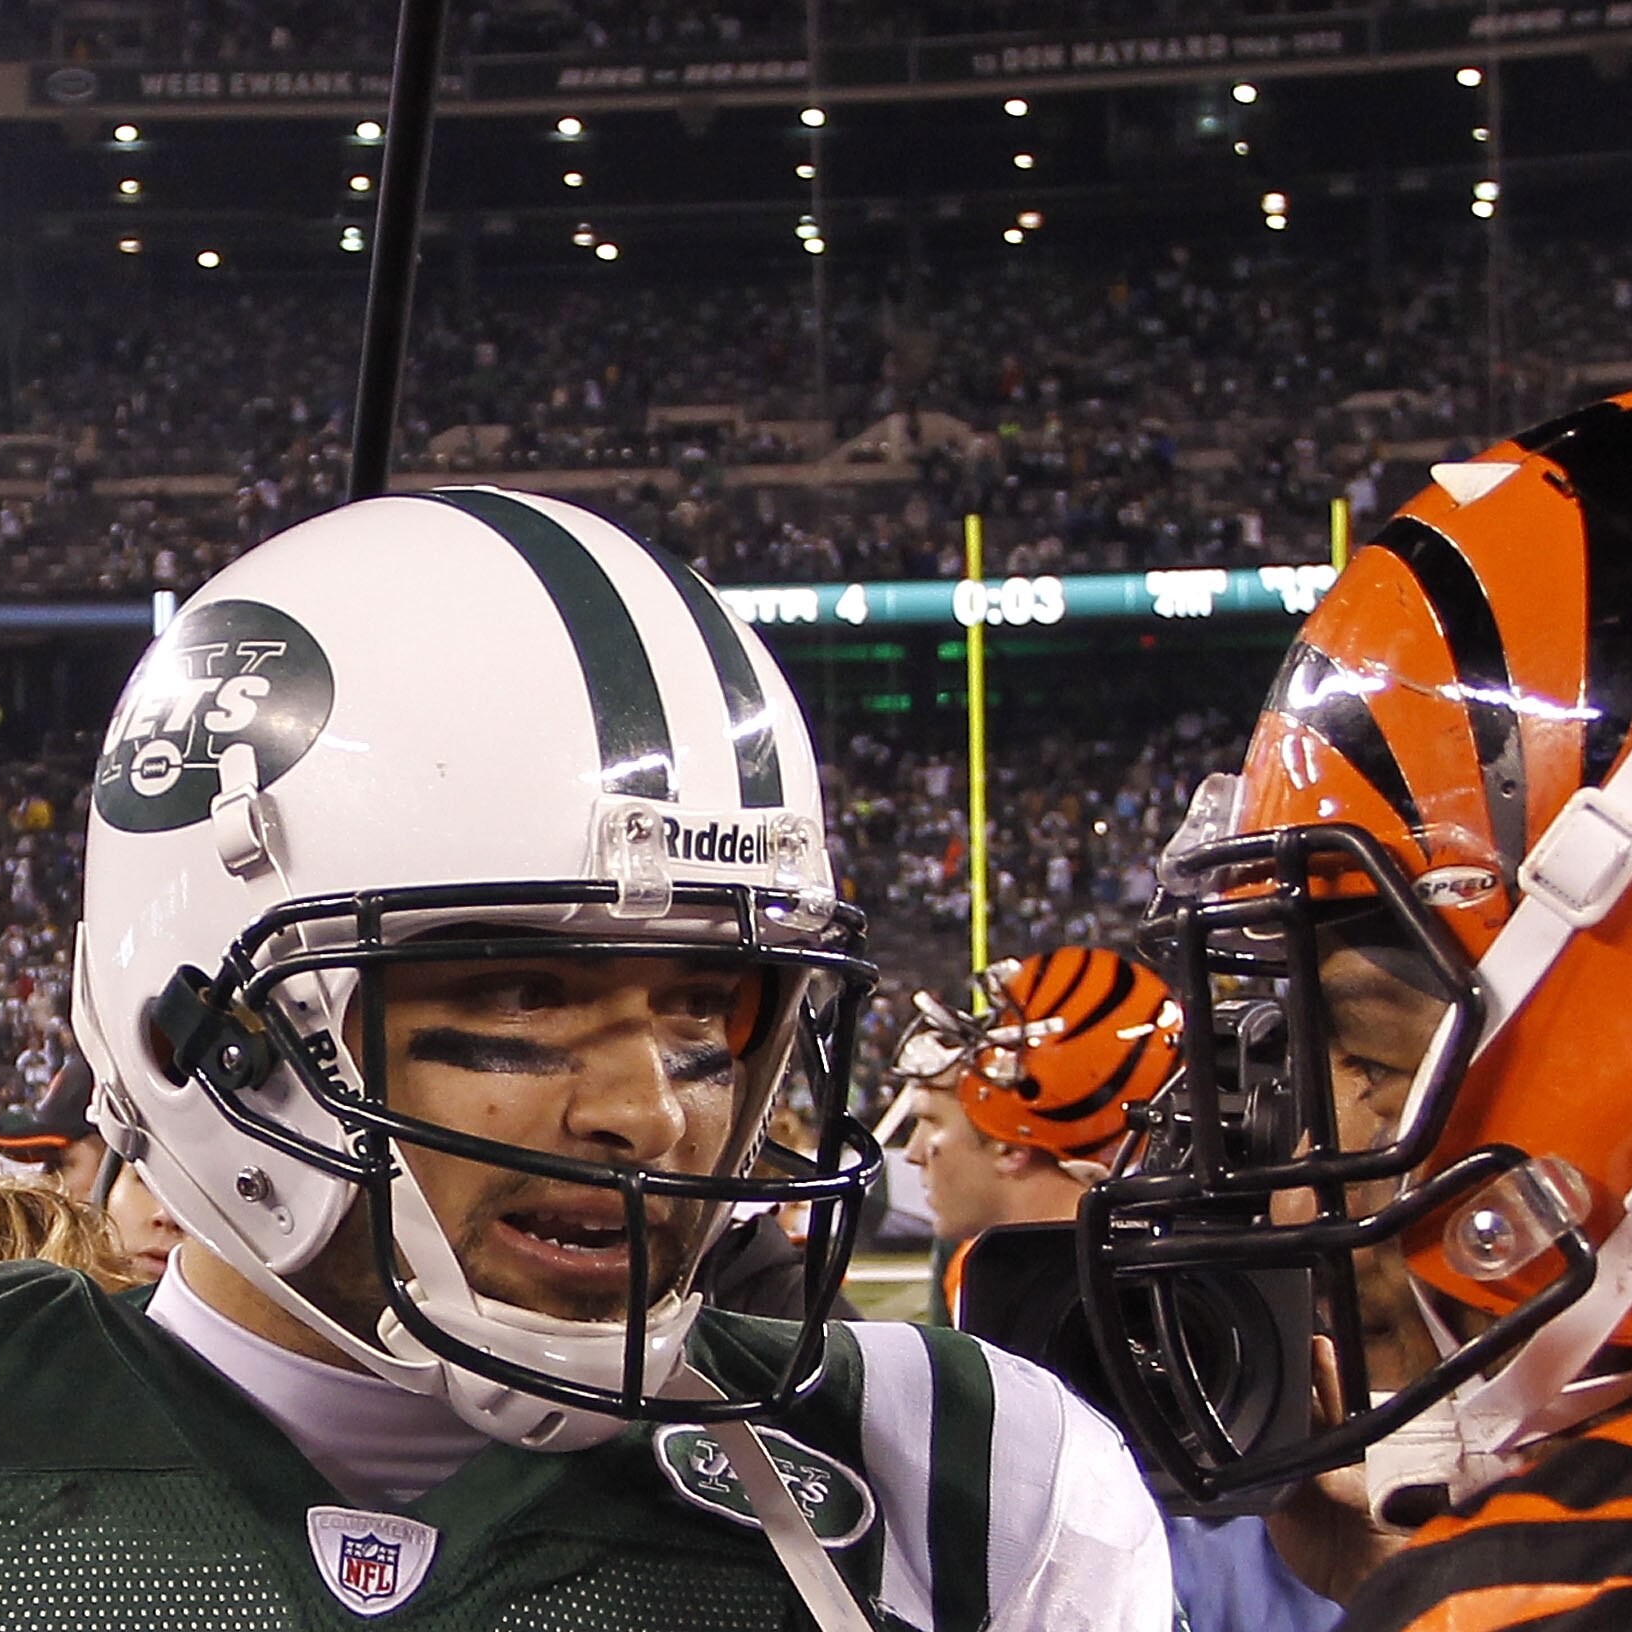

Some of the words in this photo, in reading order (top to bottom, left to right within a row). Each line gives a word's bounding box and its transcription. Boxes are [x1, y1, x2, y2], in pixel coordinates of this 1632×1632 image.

[835, 583, 868, 625] 4
[953, 575, 1066, 627] 0:03
[661, 815, 768, 866] Riddell
[1415, 874, 1498, 899] SPEED
[344, 1557, 390, 1593] NFL
